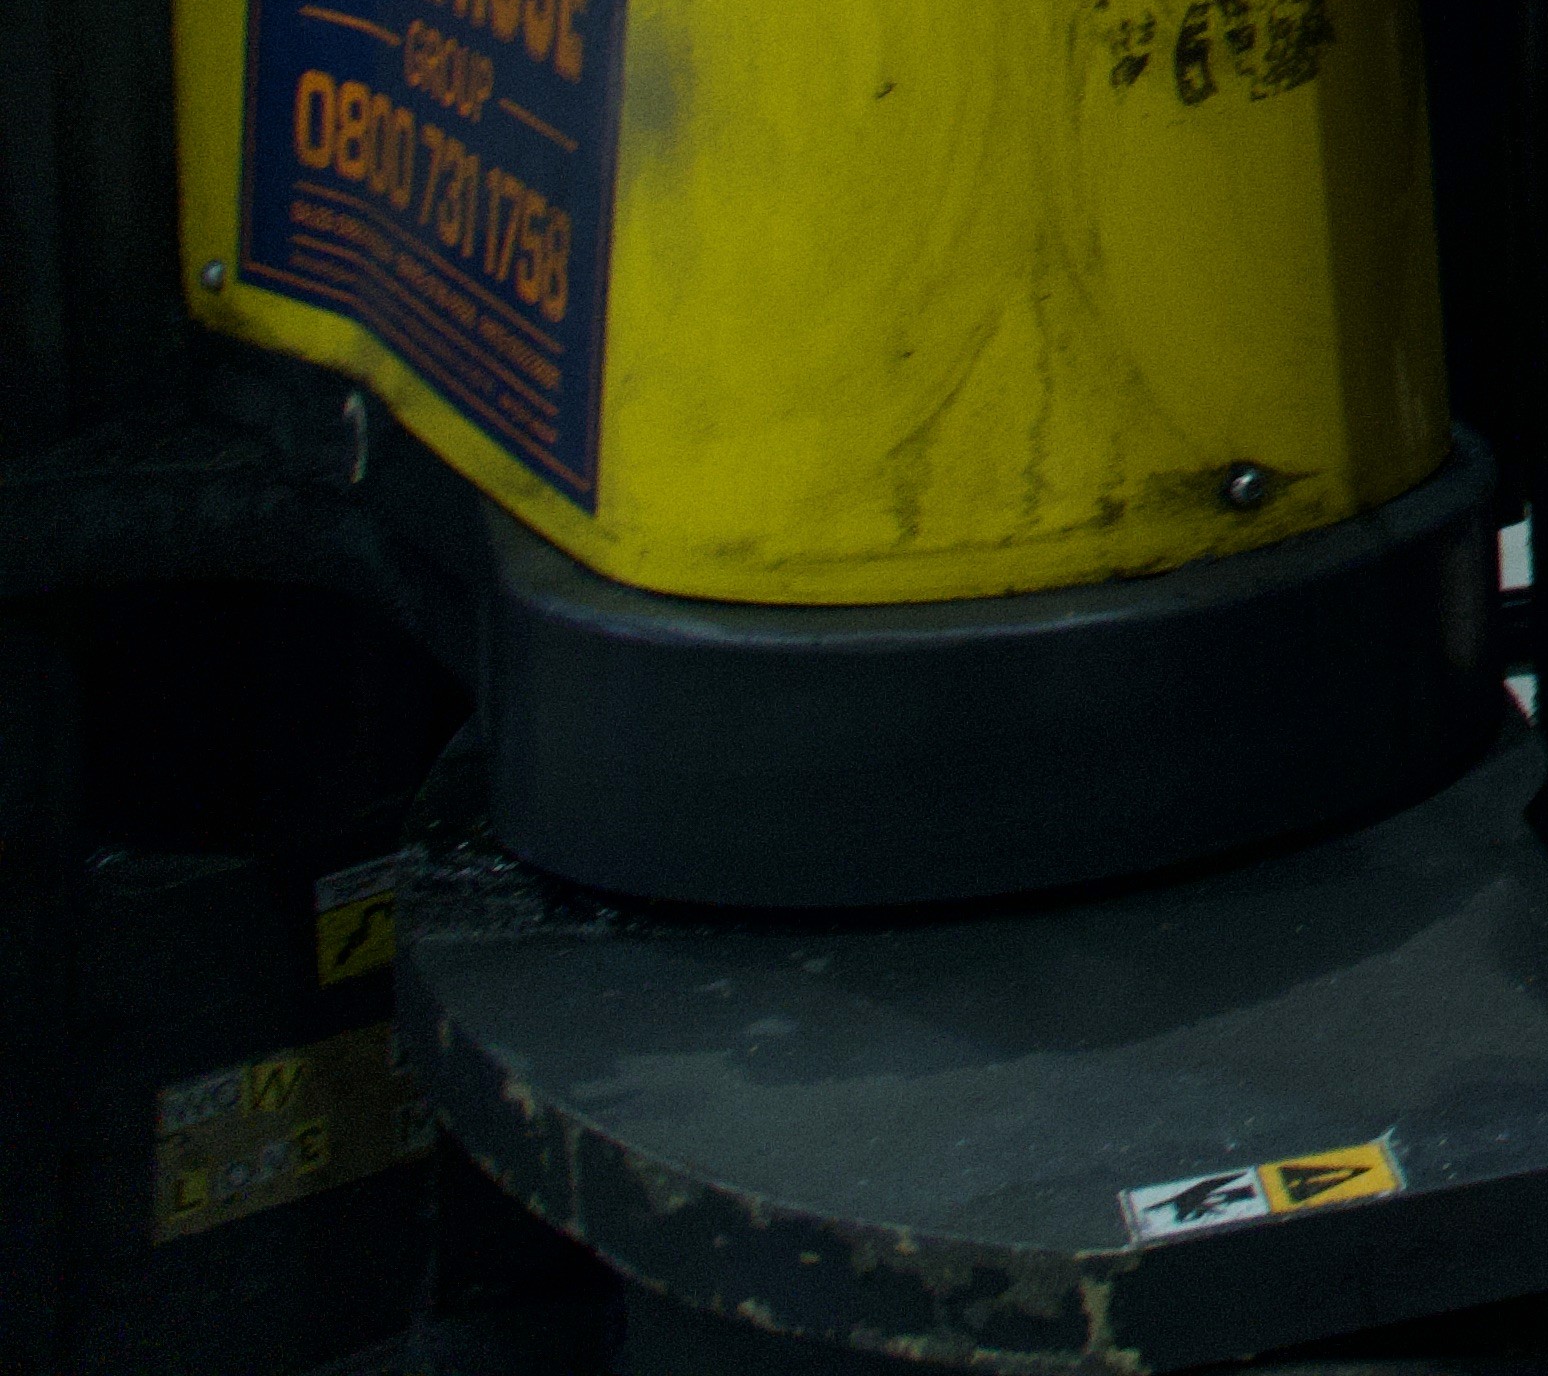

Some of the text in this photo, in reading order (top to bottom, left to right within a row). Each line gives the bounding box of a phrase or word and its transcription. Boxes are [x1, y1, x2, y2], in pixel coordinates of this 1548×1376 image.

[401, 16, 495, 124] GROUP
[292, 68, 414, 212] 0800
[417, 115, 482, 260] 731
[479, 164, 573, 326] 1758
